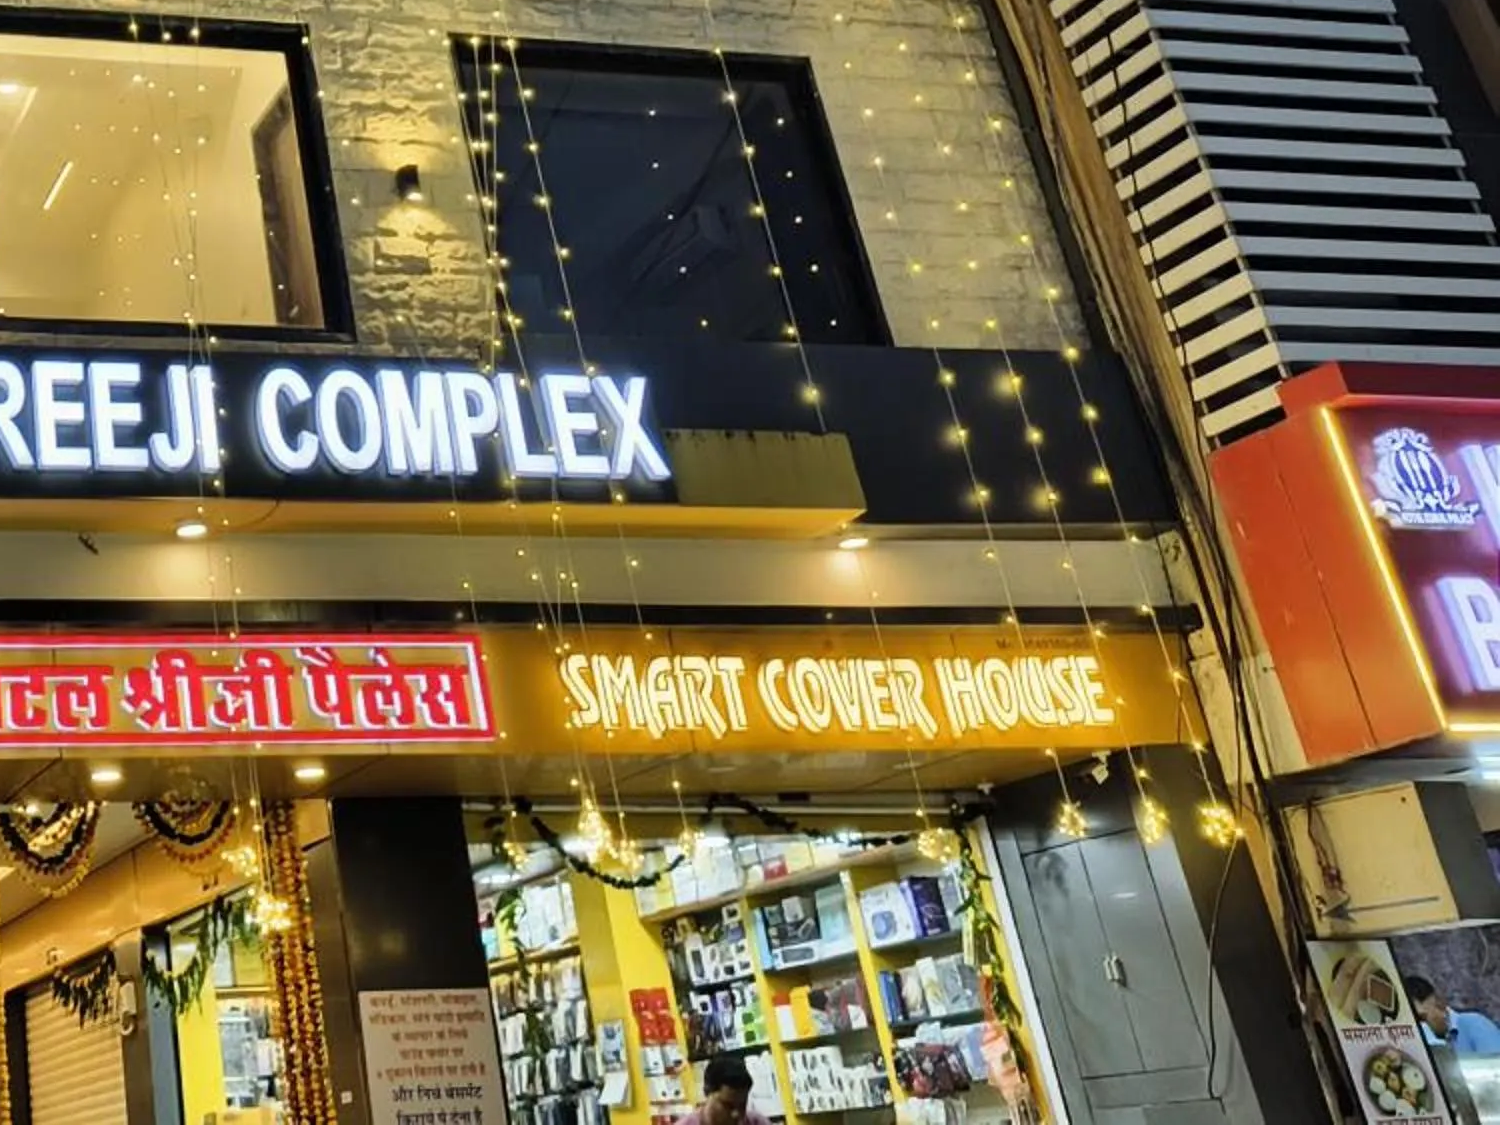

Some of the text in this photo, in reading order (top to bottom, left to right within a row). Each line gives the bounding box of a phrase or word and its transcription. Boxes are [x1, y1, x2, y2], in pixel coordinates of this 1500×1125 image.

[257, 367, 672, 482] COMPLEX
[563, 654, 1116, 741] SMART COVER HOUSE
